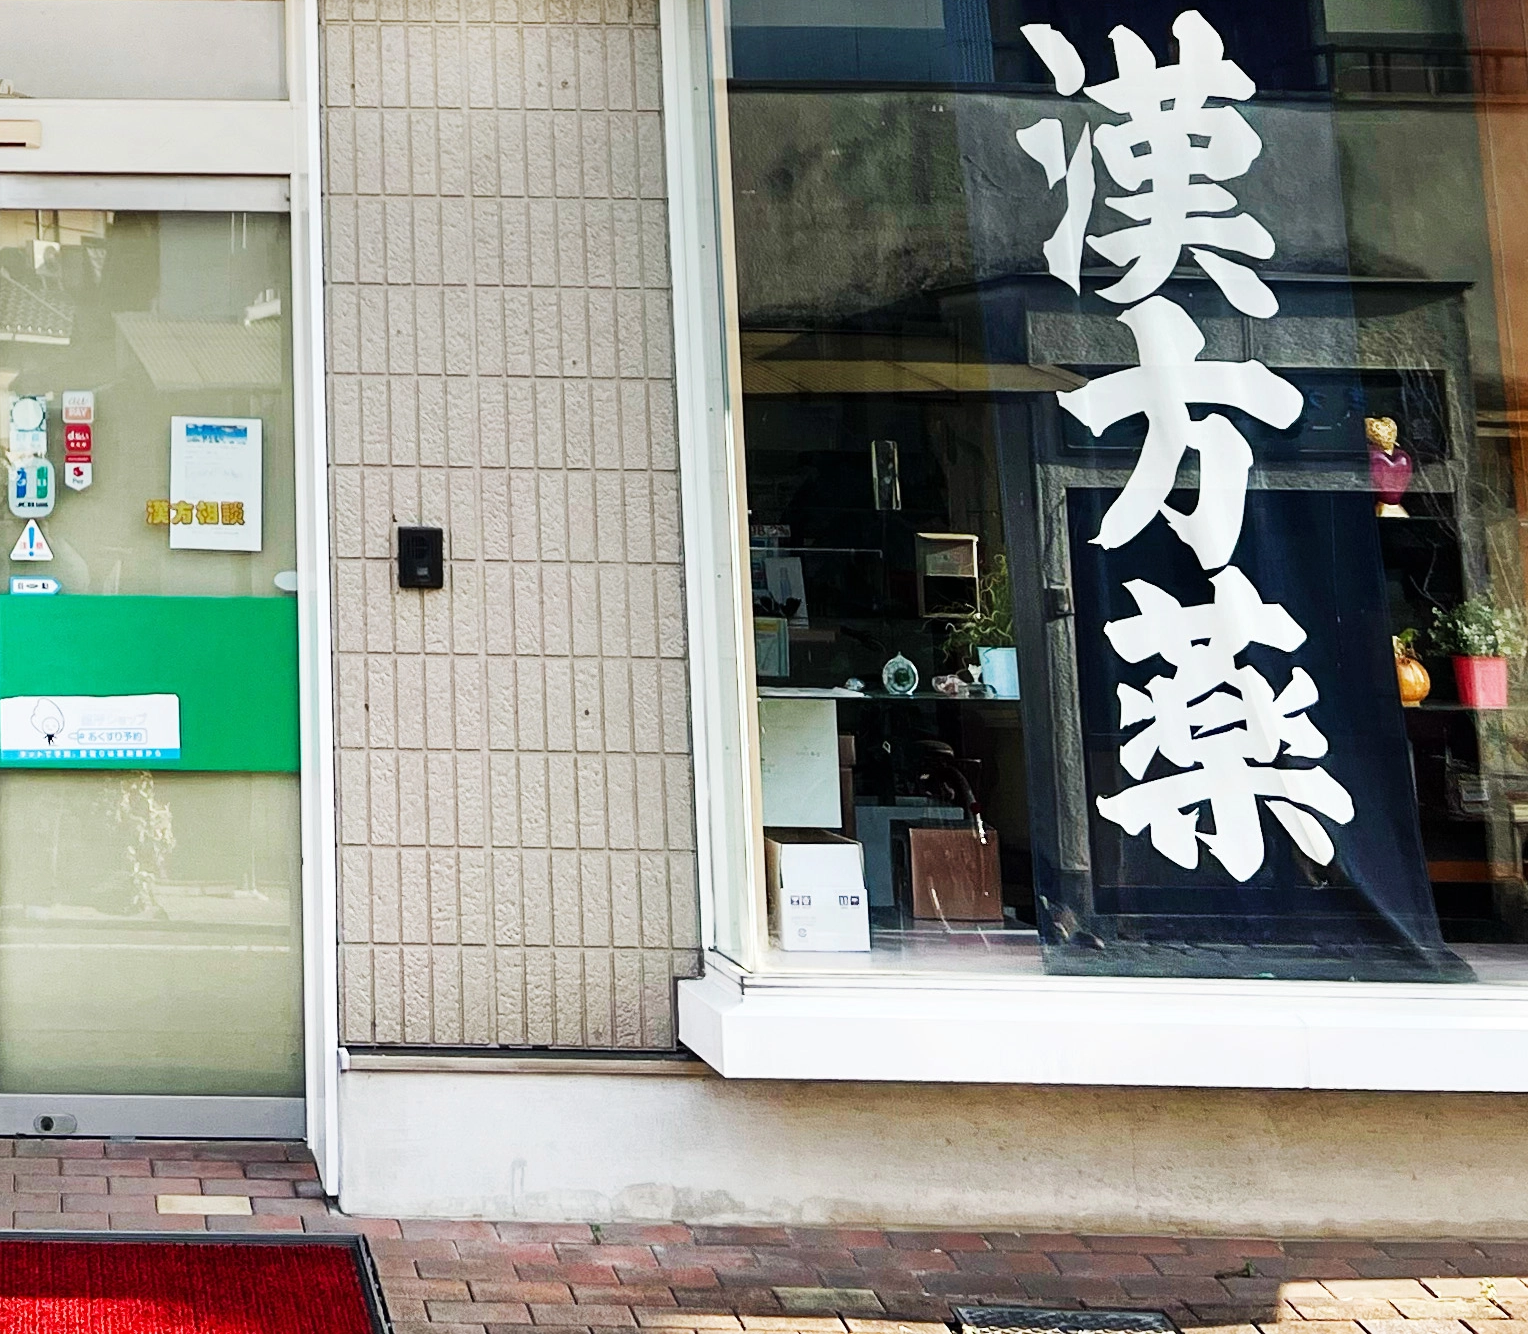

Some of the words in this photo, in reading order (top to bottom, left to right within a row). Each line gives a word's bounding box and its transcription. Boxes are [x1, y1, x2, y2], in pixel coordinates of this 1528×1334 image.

[146, 499, 246, 526] 漢方相談
[1015, 9, 1356, 882] 漢方薬
